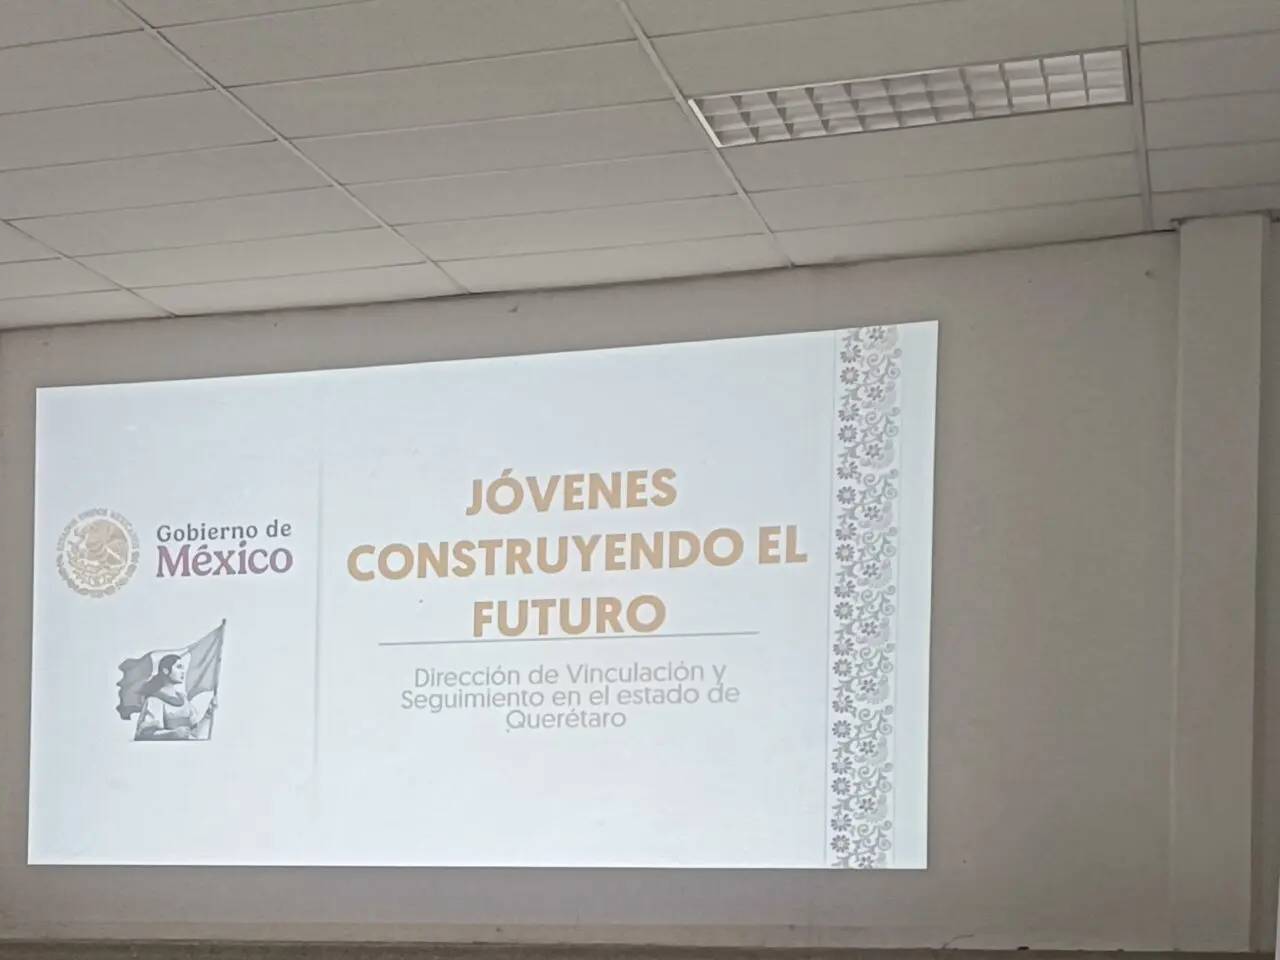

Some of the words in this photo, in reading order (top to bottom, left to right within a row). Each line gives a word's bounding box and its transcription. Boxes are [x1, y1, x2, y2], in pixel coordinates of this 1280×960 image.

[466, 468, 677, 515] JÓVENES
[157, 523, 258, 543] Gobierno
[266, 519, 292, 537] de
[156, 540, 294, 578] México
[347, 527, 744, 581] CONSTRUYENDO
[757, 524, 808, 565] EL
[473, 594, 666, 637] FUTURO
[414, 665, 520, 688] Dirección
[528, 664, 559, 685] de
[567, 661, 704, 684] Vinculación
[712, 663, 727, 685] y
[401, 687, 544, 713] Seguimiento
[552, 690, 581, 706] en
[589, 685, 609, 706] el
[617, 683, 699, 705] estado
[708, 682, 740, 704] de
[506, 707, 626, 731] Querétaro
